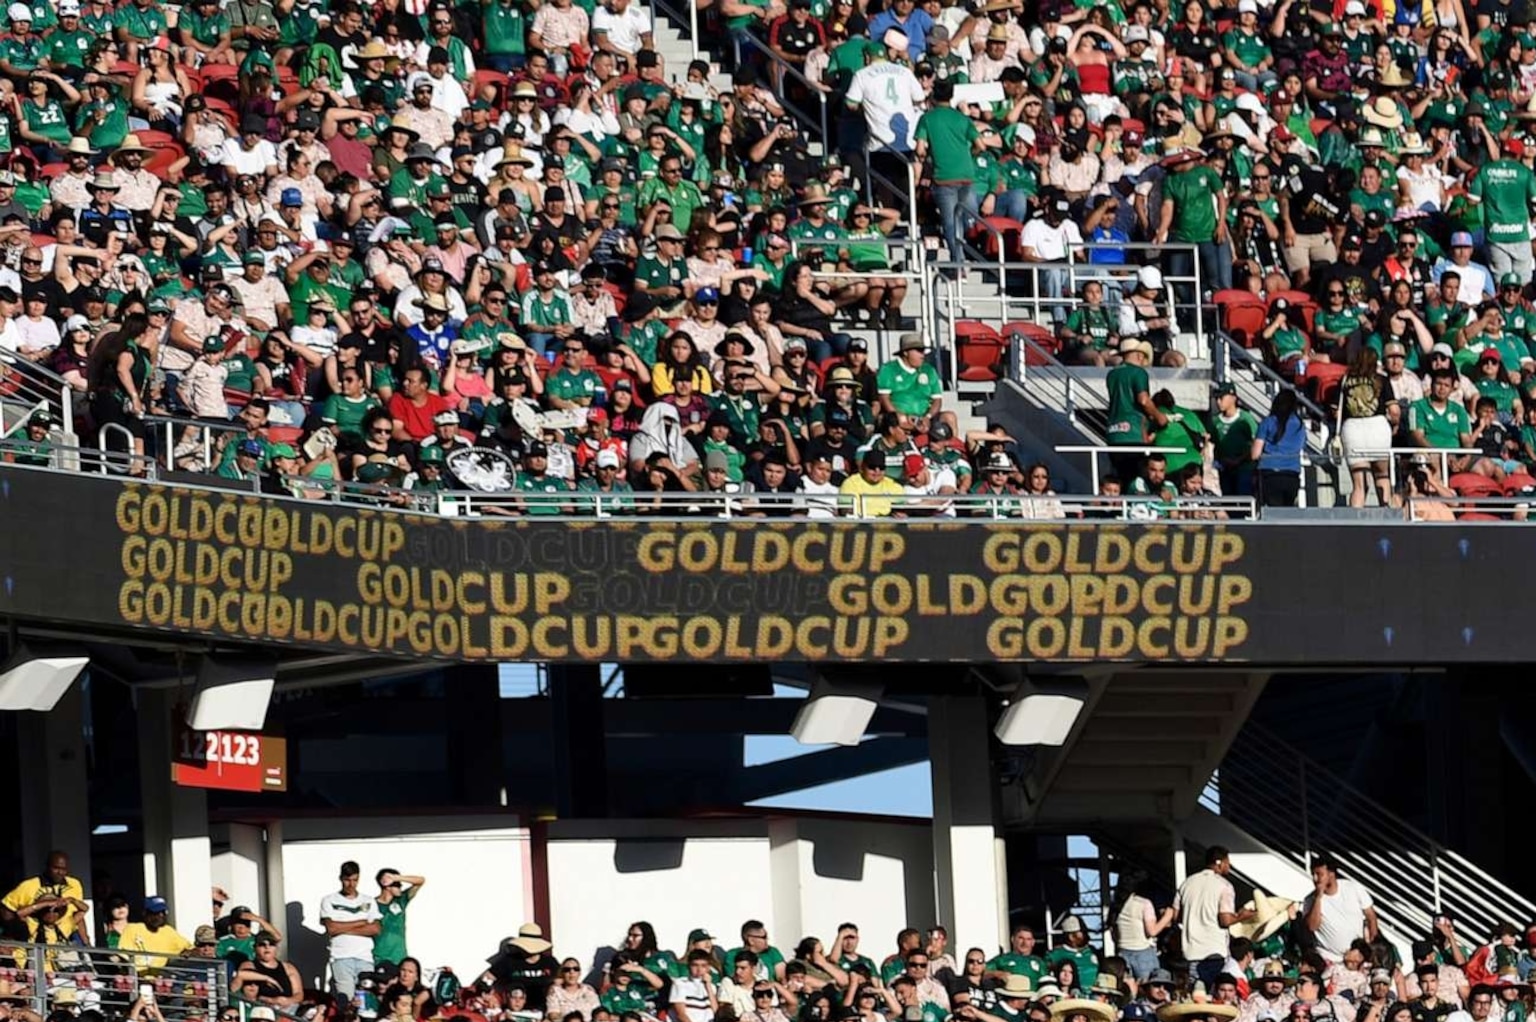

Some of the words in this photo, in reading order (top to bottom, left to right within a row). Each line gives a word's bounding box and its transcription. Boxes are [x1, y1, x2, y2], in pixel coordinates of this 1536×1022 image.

[885, 77, 900, 103] 4
[39, 110, 61, 124] 22
[637, 530, 905, 573] GOLDCUP
[983, 531, 1244, 574] GOLDCUP
[121, 534, 292, 592] GOLDCUP
[357, 562, 570, 614] GOLDCUP
[408, 609, 650, 658] GOLDCUP
[642, 615, 910, 658] GOLDCUP
[986, 616, 1248, 658] GOLDCUP
[221, 734, 260, 765] 123
